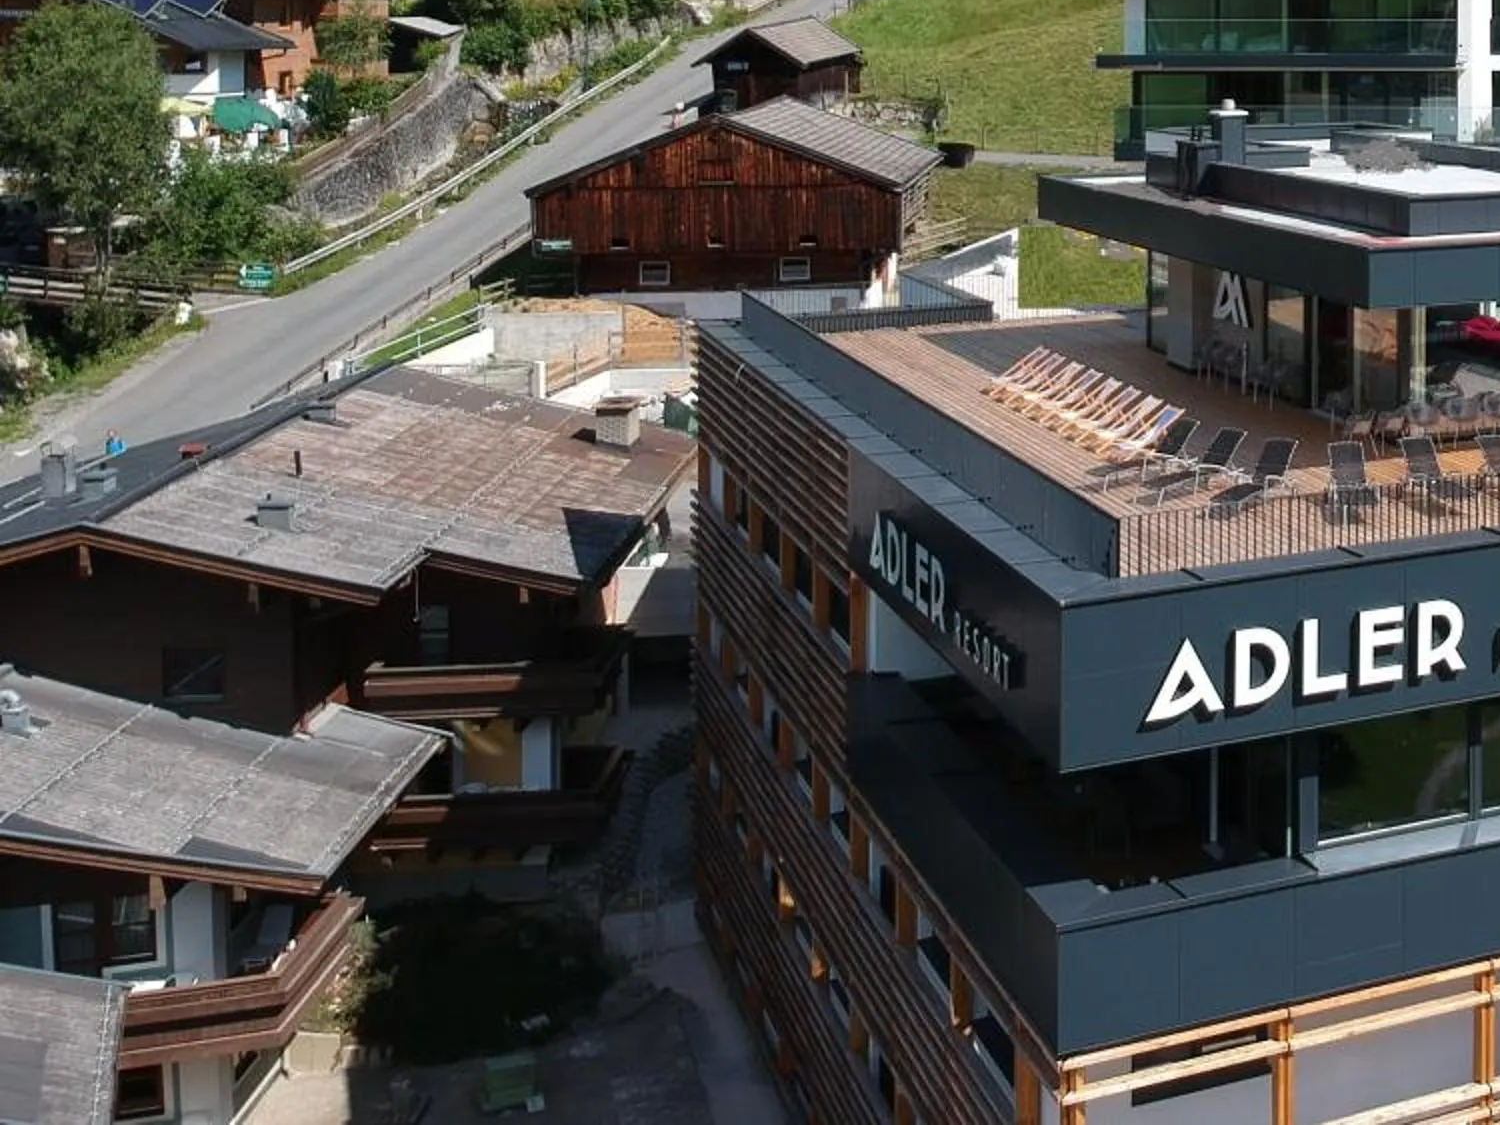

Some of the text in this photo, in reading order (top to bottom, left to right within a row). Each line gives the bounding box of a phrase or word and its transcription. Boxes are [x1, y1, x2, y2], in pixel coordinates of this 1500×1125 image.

[869, 510, 1010, 692] ADLER RESORT
[1143, 598, 1468, 724] ADLER
